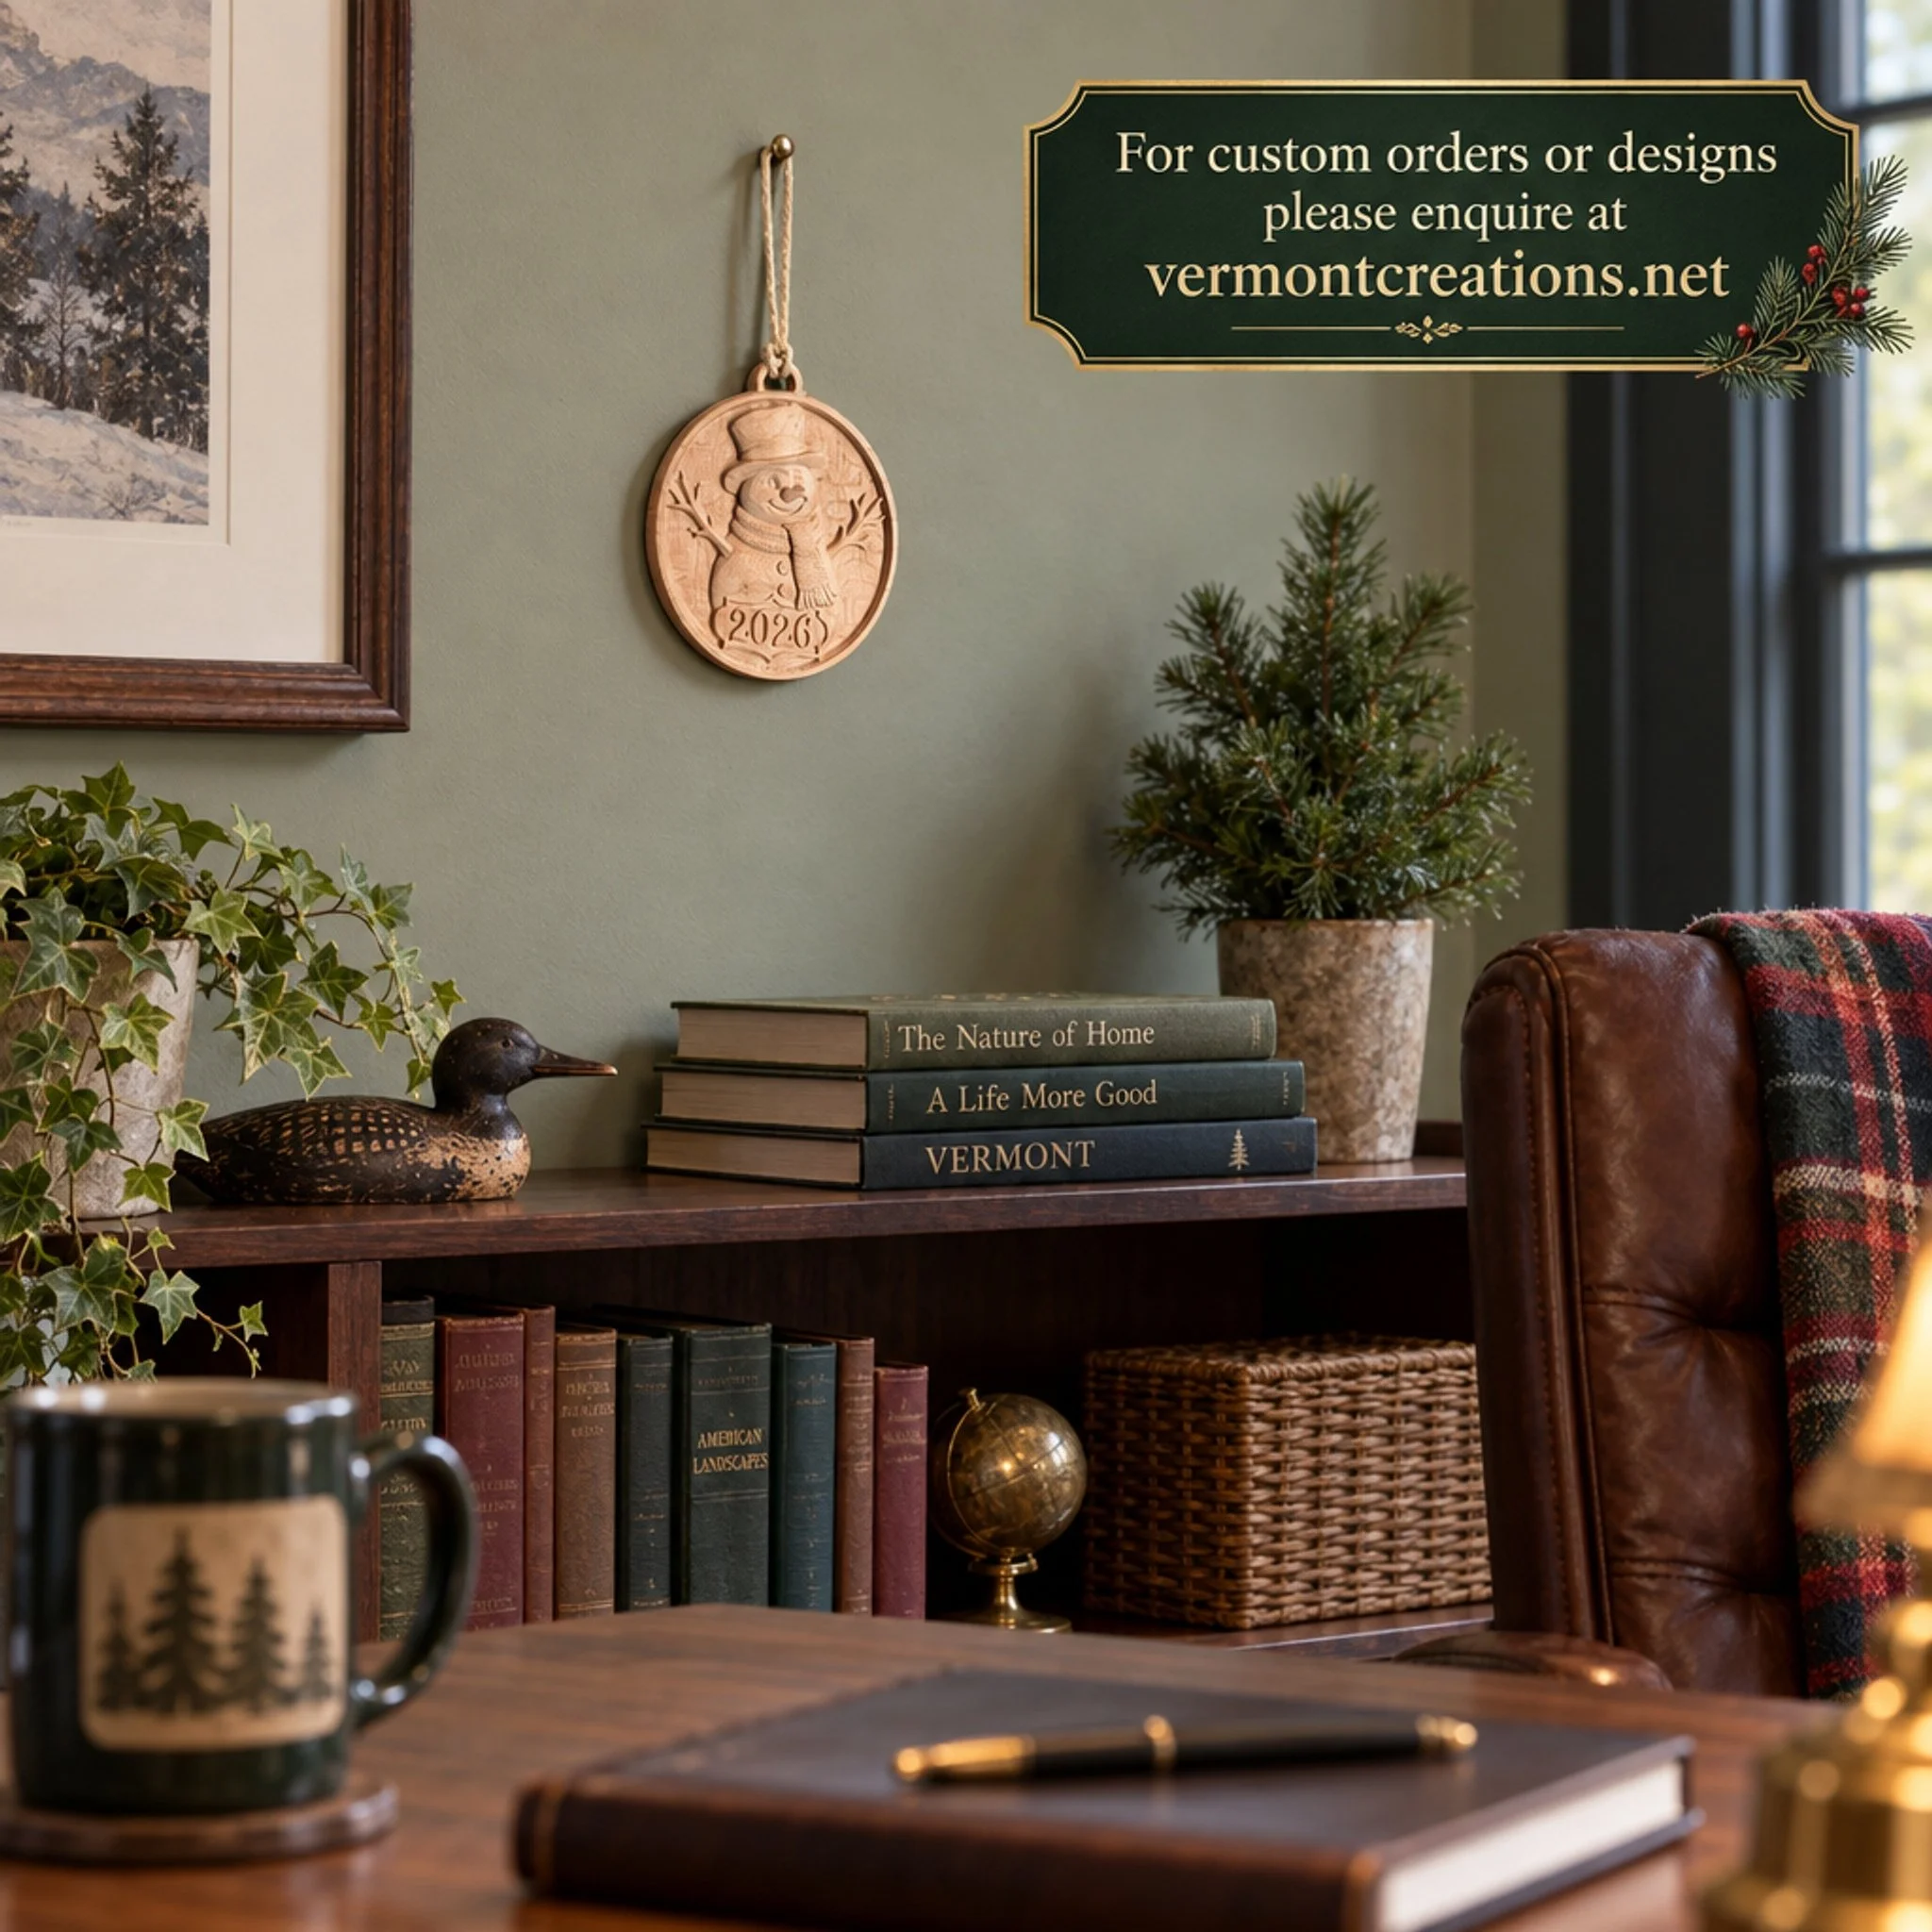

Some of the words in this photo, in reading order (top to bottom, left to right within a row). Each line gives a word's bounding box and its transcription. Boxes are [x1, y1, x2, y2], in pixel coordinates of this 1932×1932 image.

[727, 607, 811, 649] 2026
[896, 1024, 946, 1052] The
[956, 1023, 1042, 1051] Nature
[1051, 1019, 1079, 1047] of
[1086, 1019, 1156, 1047] Home
[926, 1086, 949, 1113] A
[958, 1083, 1010, 1113] Life
[1021, 1081, 1087, 1110] More
[1094, 1077, 1158, 1107] Good
[924, 1139, 1096, 1174] VERMONT
[697, 1427, 763, 1450] AMERICAN
[692, 1452, 769, 1475] LANDSCAPES
